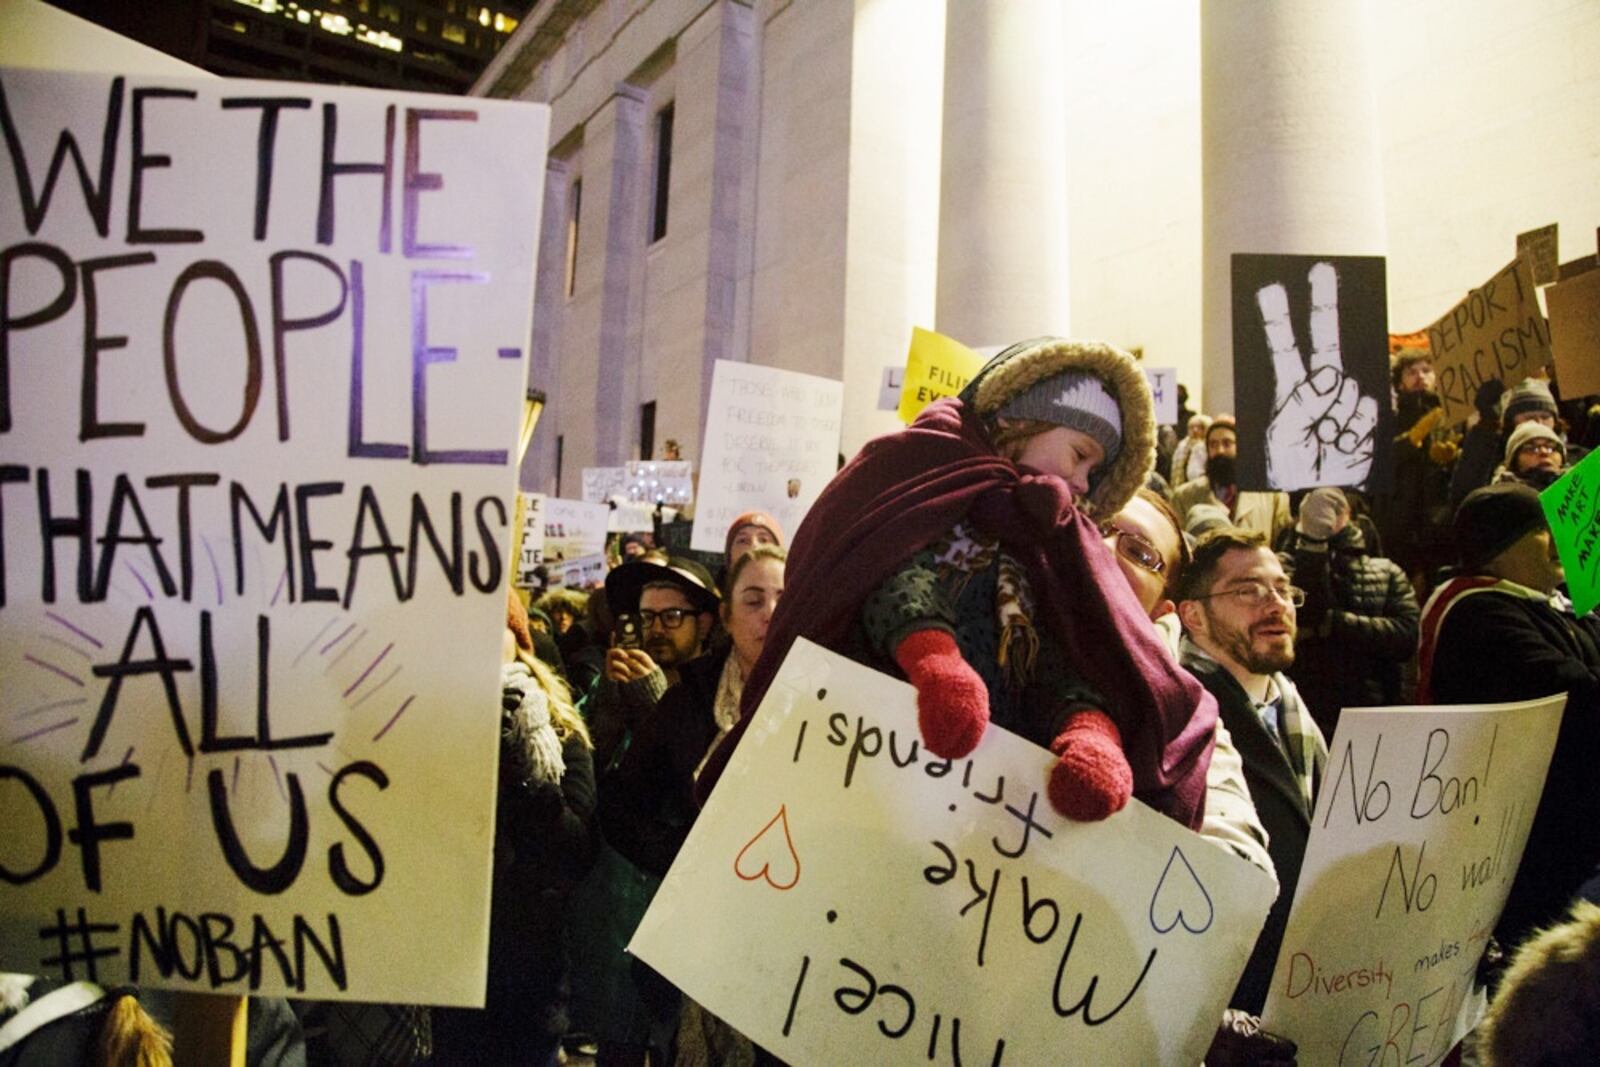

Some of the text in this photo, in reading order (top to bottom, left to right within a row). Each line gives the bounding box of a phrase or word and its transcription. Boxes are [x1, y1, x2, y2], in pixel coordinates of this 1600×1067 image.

[0, 76, 478, 258] WE THE
[1429, 260, 1523, 360] DEPORT
[230, 480, 507, 608] MEANS
[1557, 472, 1584, 525] MAKE
[1571, 485, 1588, 526] ART
[80, 606, 334, 763] ALL
[793, 688, 1054, 859] friends!
[1323, 723, 1499, 829] No Ban!
[0, 760, 390, 897] OF US
[1375, 840, 1438, 919] No
[39, 906, 347, 992] #NOBAN
[923, 841, 1158, 1026] Make
[1286, 938, 1461, 999] Diversity makes
